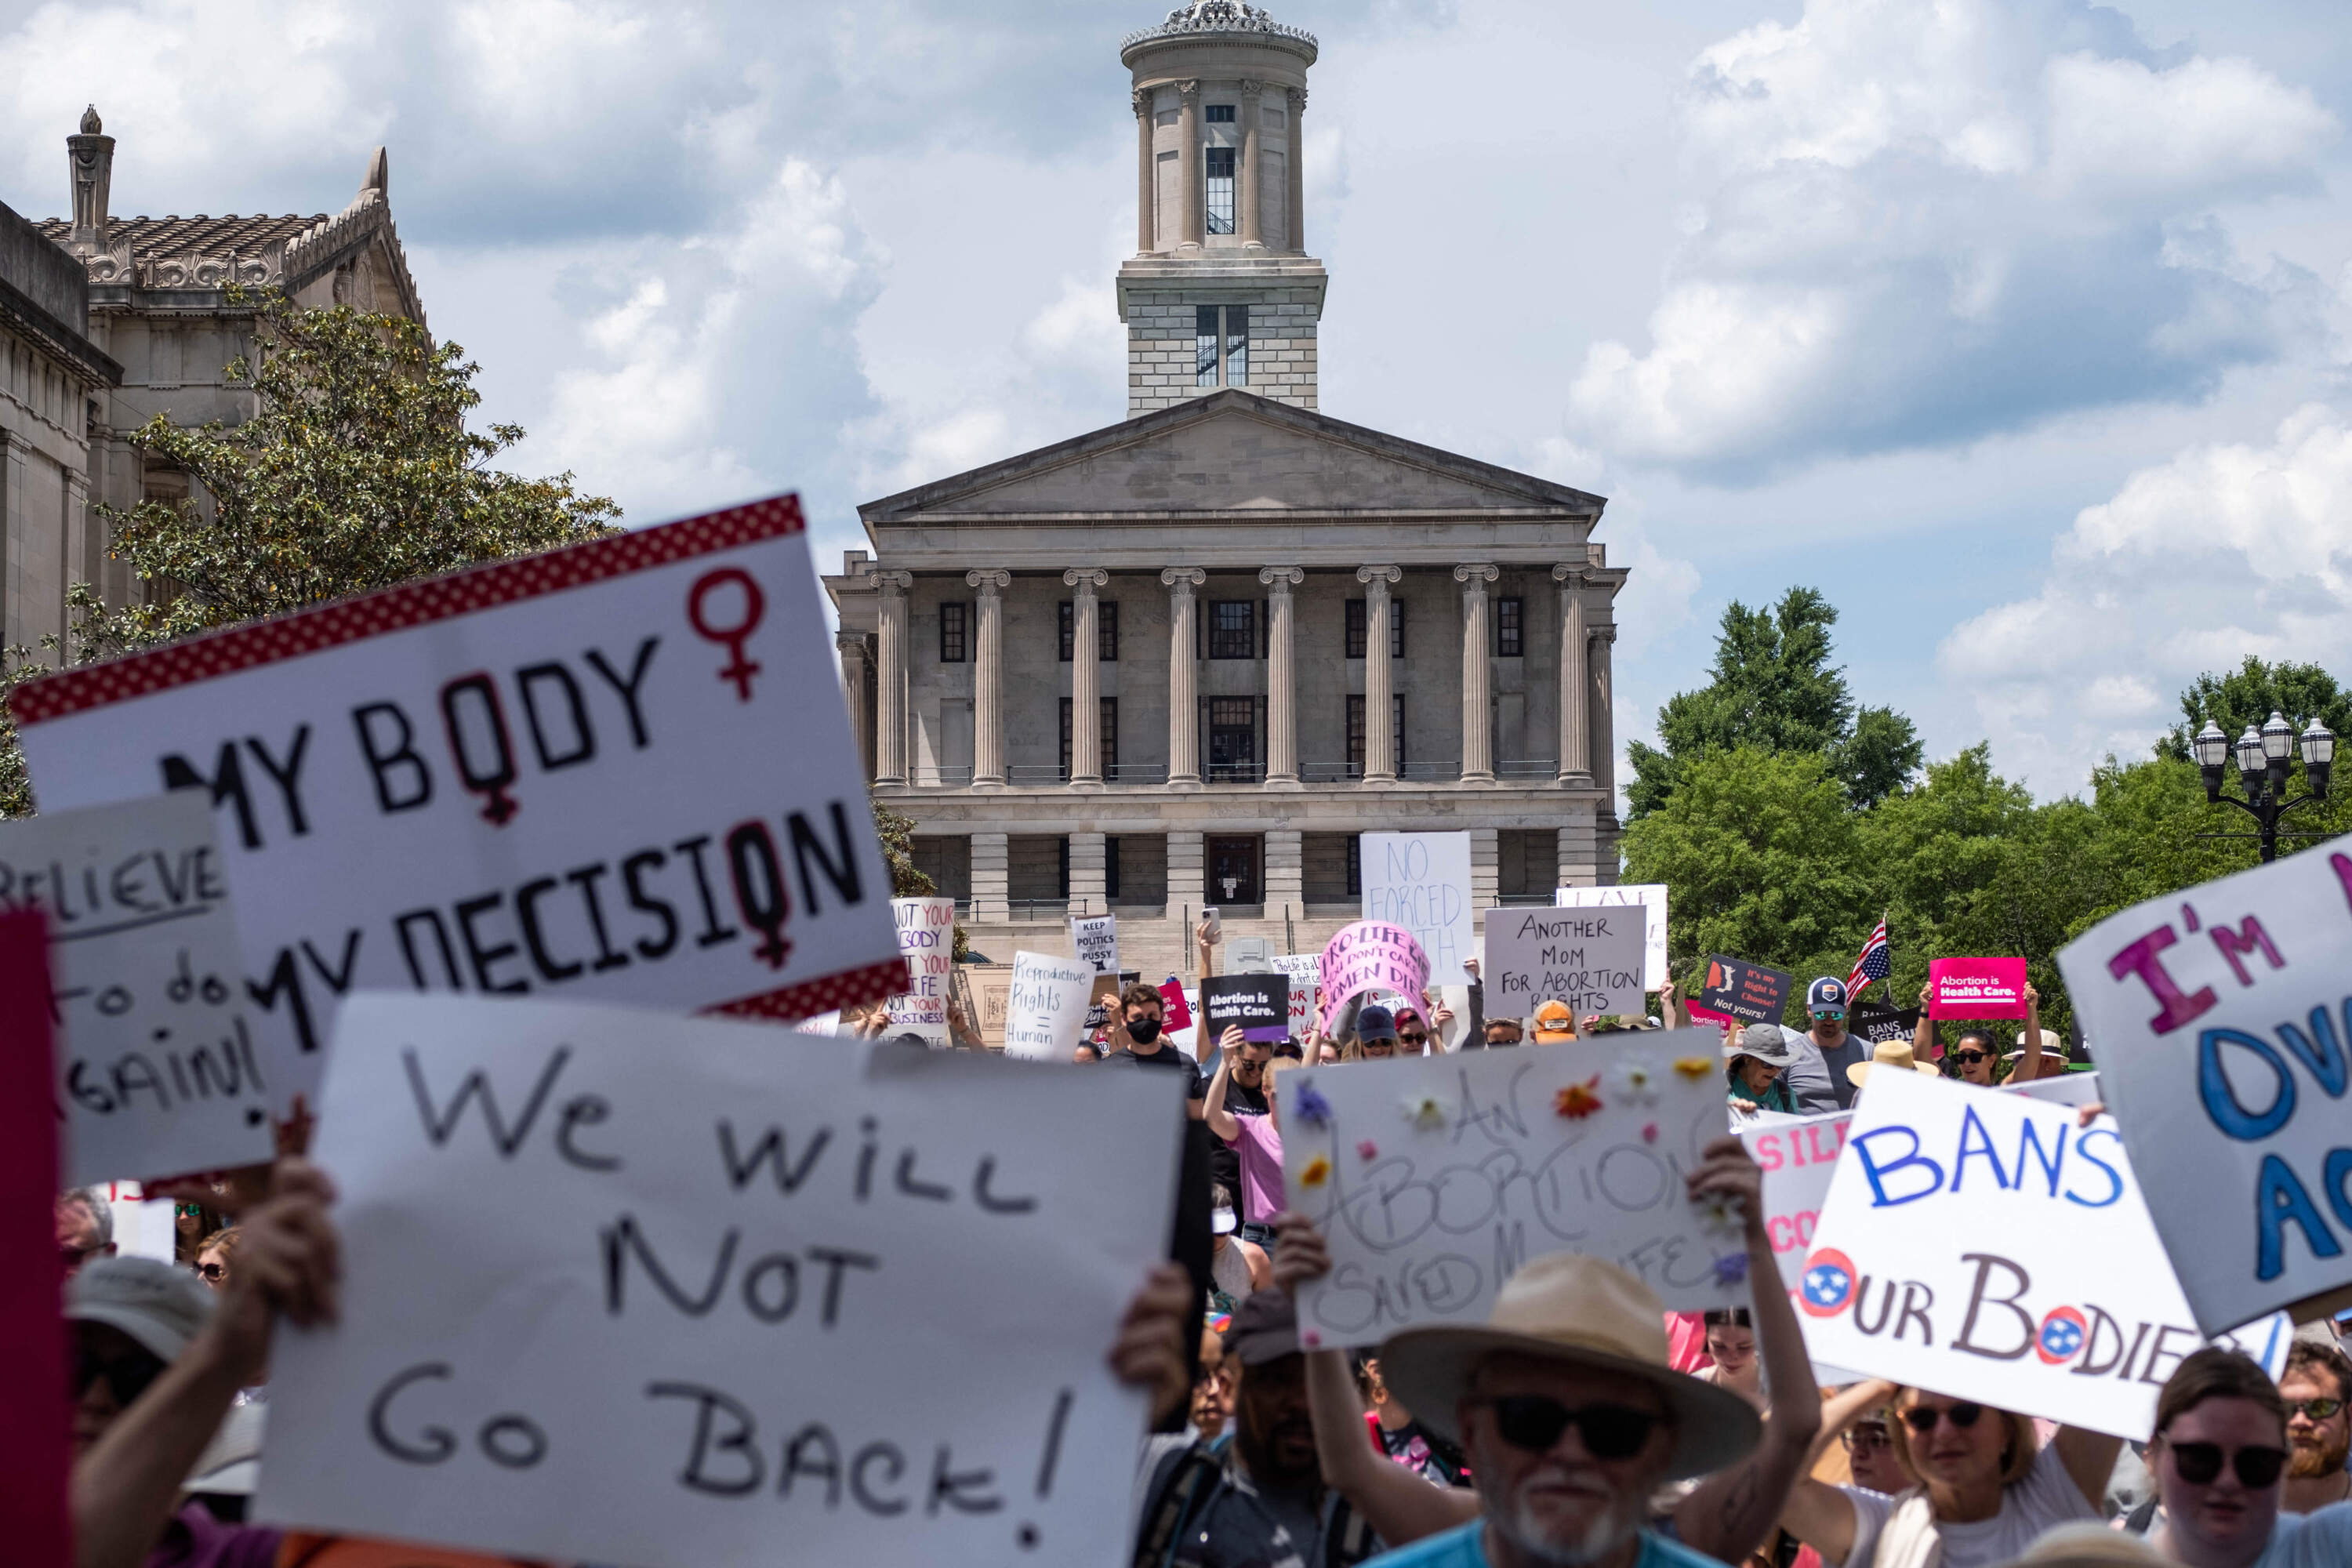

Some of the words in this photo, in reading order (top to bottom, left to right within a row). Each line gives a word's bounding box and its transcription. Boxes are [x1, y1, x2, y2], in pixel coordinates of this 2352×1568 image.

[161, 723, 310, 849] MY
[351, 636, 662, 815] BODY
[1387, 840, 1428, 883] NO
[394, 800, 864, 994] DECISION
[1370, 884, 1461, 927] FORCED
[922, 904, 955, 927] YOUR
[1083, 921, 1106, 931] KEEP
[1516, 913, 1614, 941] ANOTHER
[899, 928, 942, 950] BODY
[1076, 935, 1115, 946] POLITICS
[1082, 949, 1112, 961] PUSSY
[1322, 926, 1406, 979] PRO-LIFE
[1347, 946, 1387, 965] DON'T
[1541, 945, 1584, 968] MOM
[166, 946, 230, 1005] do
[1014, 954, 1087, 987] Reproductive
[1747, 968, 1761, 980] It's
[1762, 975, 1777, 985] my
[1940, 975, 1988, 985] Abortion
[1990, 975, 2000, 985] is
[2107, 902, 2287, 1036] I'M
[906, 975, 938, 997] IFE
[1501, 971, 1531, 994] FOR
[1541, 967, 1640, 993] ABORTION
[1744, 980, 1767, 994] Right
[1768, 988, 1778, 996] to
[1940, 986, 1982, 996] Health
[1983, 986, 2016, 997] Care.
[1012, 982, 1061, 1014] Rights
[1210, 992, 1256, 1006] Abortion
[1257, 991, 1269, 1004] is
[1321, 962, 1381, 1022] WOMEN
[1389, 966, 1421, 1003] DIE
[1740, 992, 1777, 1008] Choose!
[910, 997, 942, 1011] YOUR
[1210, 1005, 1241, 1019] Health
[1242, 1004, 1276, 1017] Care.
[1714, 998, 1733, 1011] Not
[1732, 1005, 1767, 1020] yours!
[889, 1011, 945, 1025] BUSINESS
[1690, 1014, 1719, 1025] bortion
[1867, 1020, 1901, 1036] BANS
[1007, 1022, 1053, 1046] Human
[1893, 1028, 1915, 1040] OU
[53, 1015, 268, 1127] GAIN!
[402, 1044, 627, 1173] We
[1850, 1102, 2125, 1209] BANS
[1798, 1246, 1935, 1346] OUR
